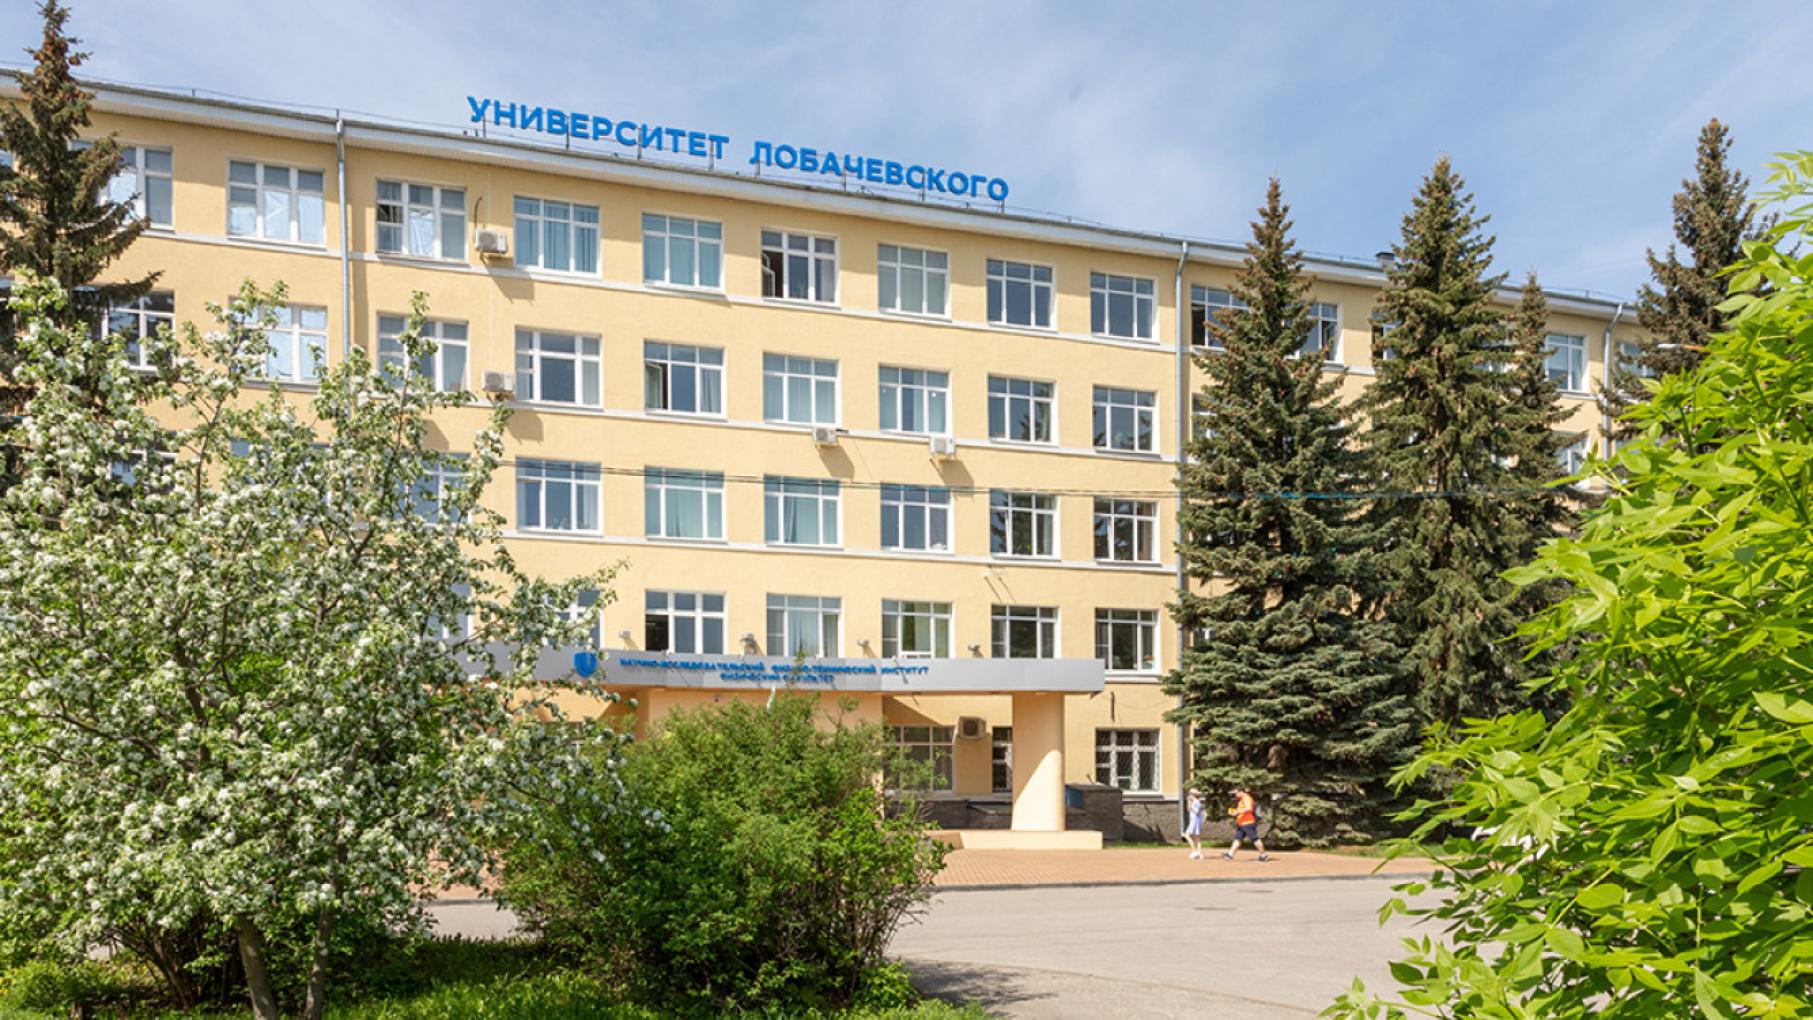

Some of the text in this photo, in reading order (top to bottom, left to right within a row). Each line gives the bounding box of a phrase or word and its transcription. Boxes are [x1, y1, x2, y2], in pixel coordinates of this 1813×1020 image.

[467, 95, 1009, 201] УНИВЕРСИТЕТ ЛОБАЧЕВСКОГО
[770, 663, 877, 674] ФИЗКО-ТЕХНИЧЕСКИЙ
